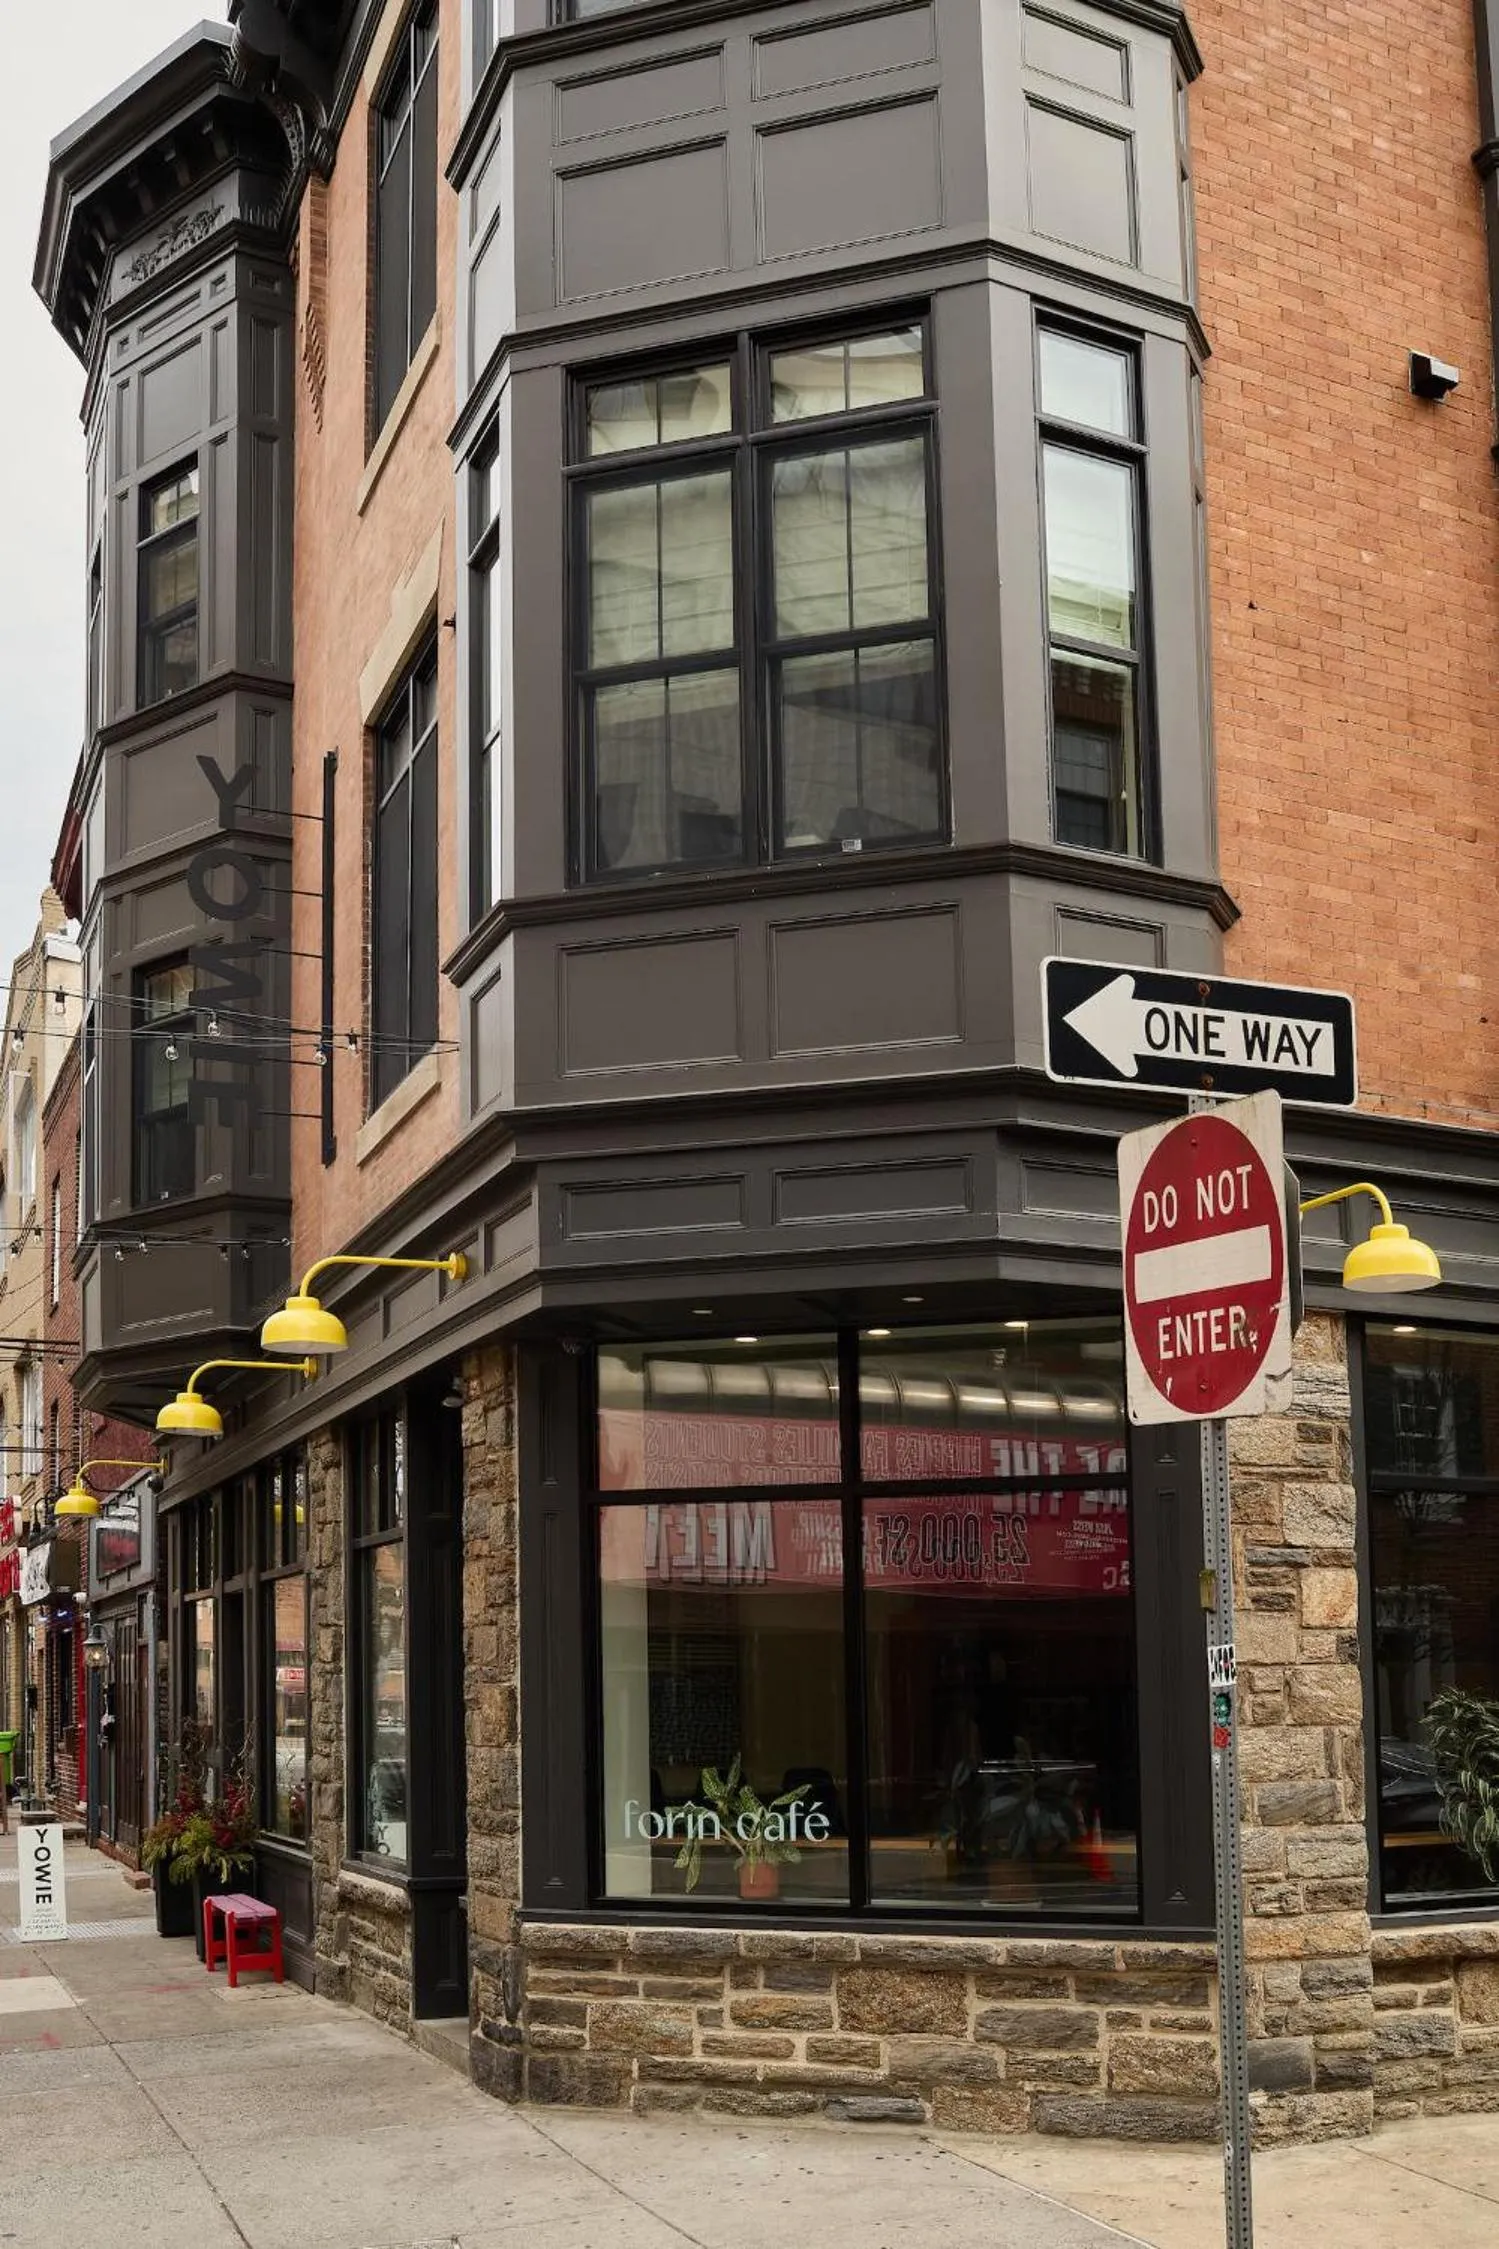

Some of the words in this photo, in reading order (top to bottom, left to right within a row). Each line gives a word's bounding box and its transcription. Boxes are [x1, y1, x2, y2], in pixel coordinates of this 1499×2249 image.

[188, 754, 263, 1127] YOWIE
[1144, 1006, 1227, 1059] ONE
[1242, 1018, 1322, 1068] WAY
[1143, 1185, 1178, 1234] DO
[1196, 1163, 1253, 1220] NOT
[1157, 1304, 1249, 1360] ENTER
[736, 1800, 830, 1842] café
[34, 1828, 52, 1905] YOWIE
